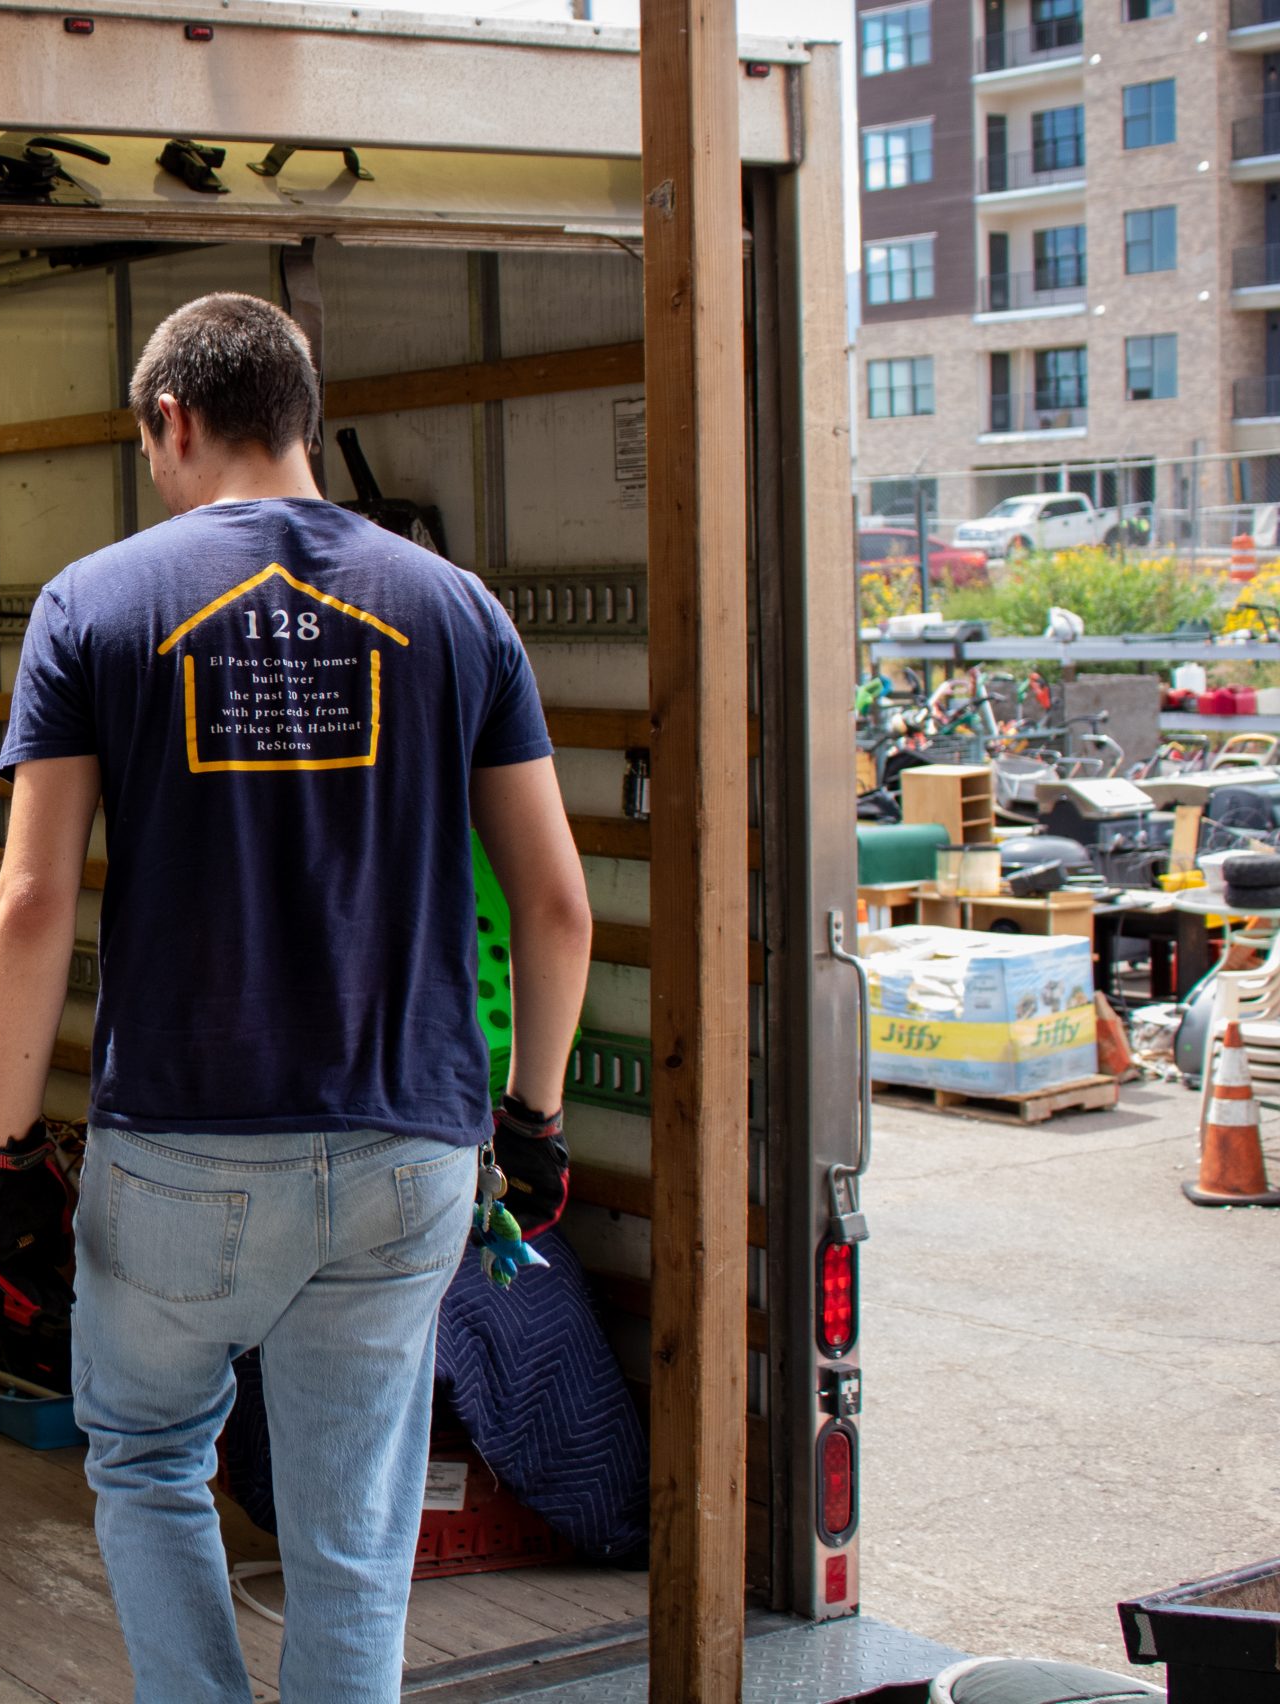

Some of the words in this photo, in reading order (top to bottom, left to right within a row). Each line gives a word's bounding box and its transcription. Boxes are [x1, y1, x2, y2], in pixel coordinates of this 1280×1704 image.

[243, 609, 320, 640] 128
[209, 655, 223, 667] El
[228, 656, 258, 667] Paso
[262, 657, 308, 670] County
[313, 656, 358, 668] homes
[252, 673, 285, 684] built
[229, 690, 250, 700] the
[255, 690, 283, 703] past
[302, 690, 340, 703] years
[221, 707, 249, 717] with
[315, 706, 349, 716] from
[210, 724, 232, 734] the
[234, 723, 271, 734] Pikes
[276, 723, 303, 734] Peak
[307, 721, 361, 734] Habitat
[256, 740, 312, 751] ReStores
[880, 1022, 942, 1051] Jiffy
[1030, 1016, 1081, 1047] Jiffy
